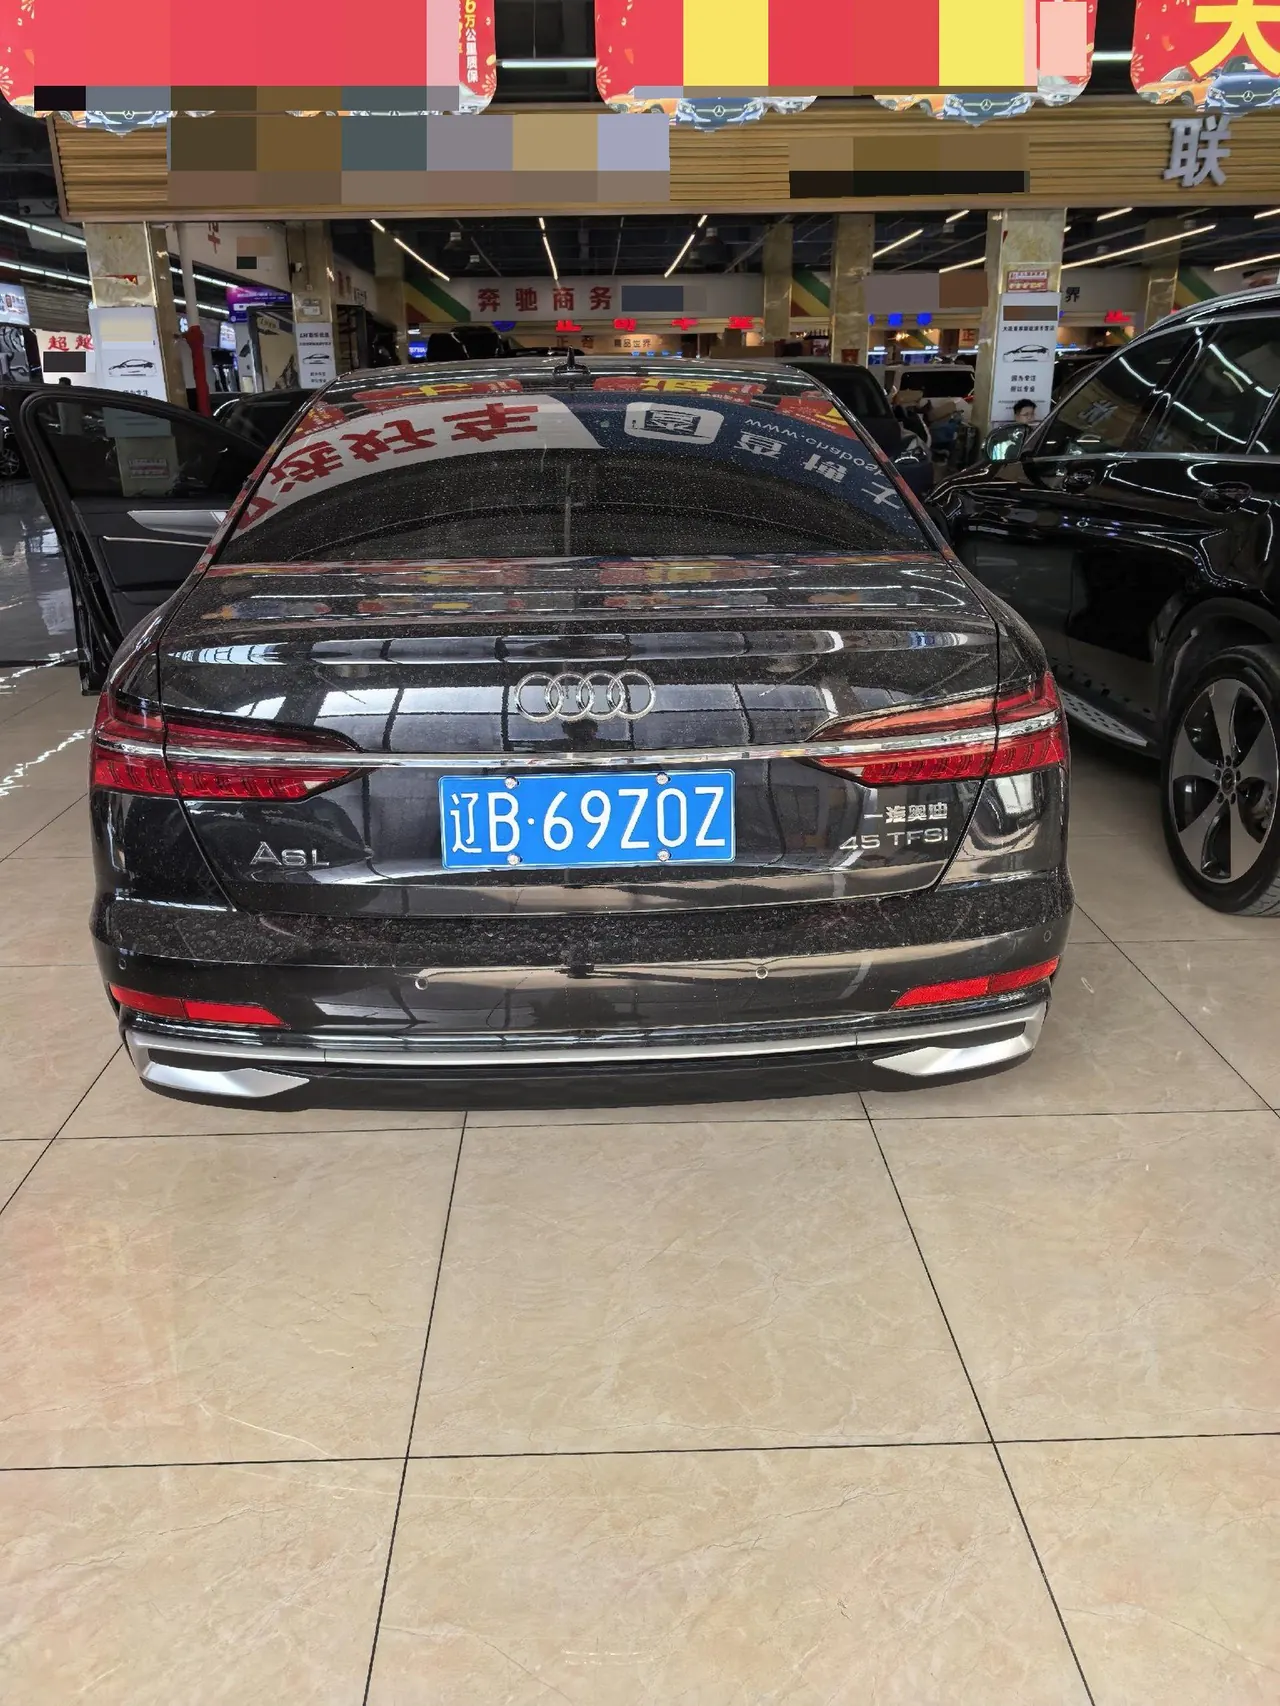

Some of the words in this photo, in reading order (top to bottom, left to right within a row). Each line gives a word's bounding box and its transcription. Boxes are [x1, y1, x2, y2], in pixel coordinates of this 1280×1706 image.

[1163, 114, 1232, 187] 联
[478, 286, 612, 312] 奔驰商务
[863, 802, 949, 824] 一汽奥迪
[839, 834, 880, 850] 45
[886, 827, 949, 846] TFSI
[250, 841, 330, 867] A6L
